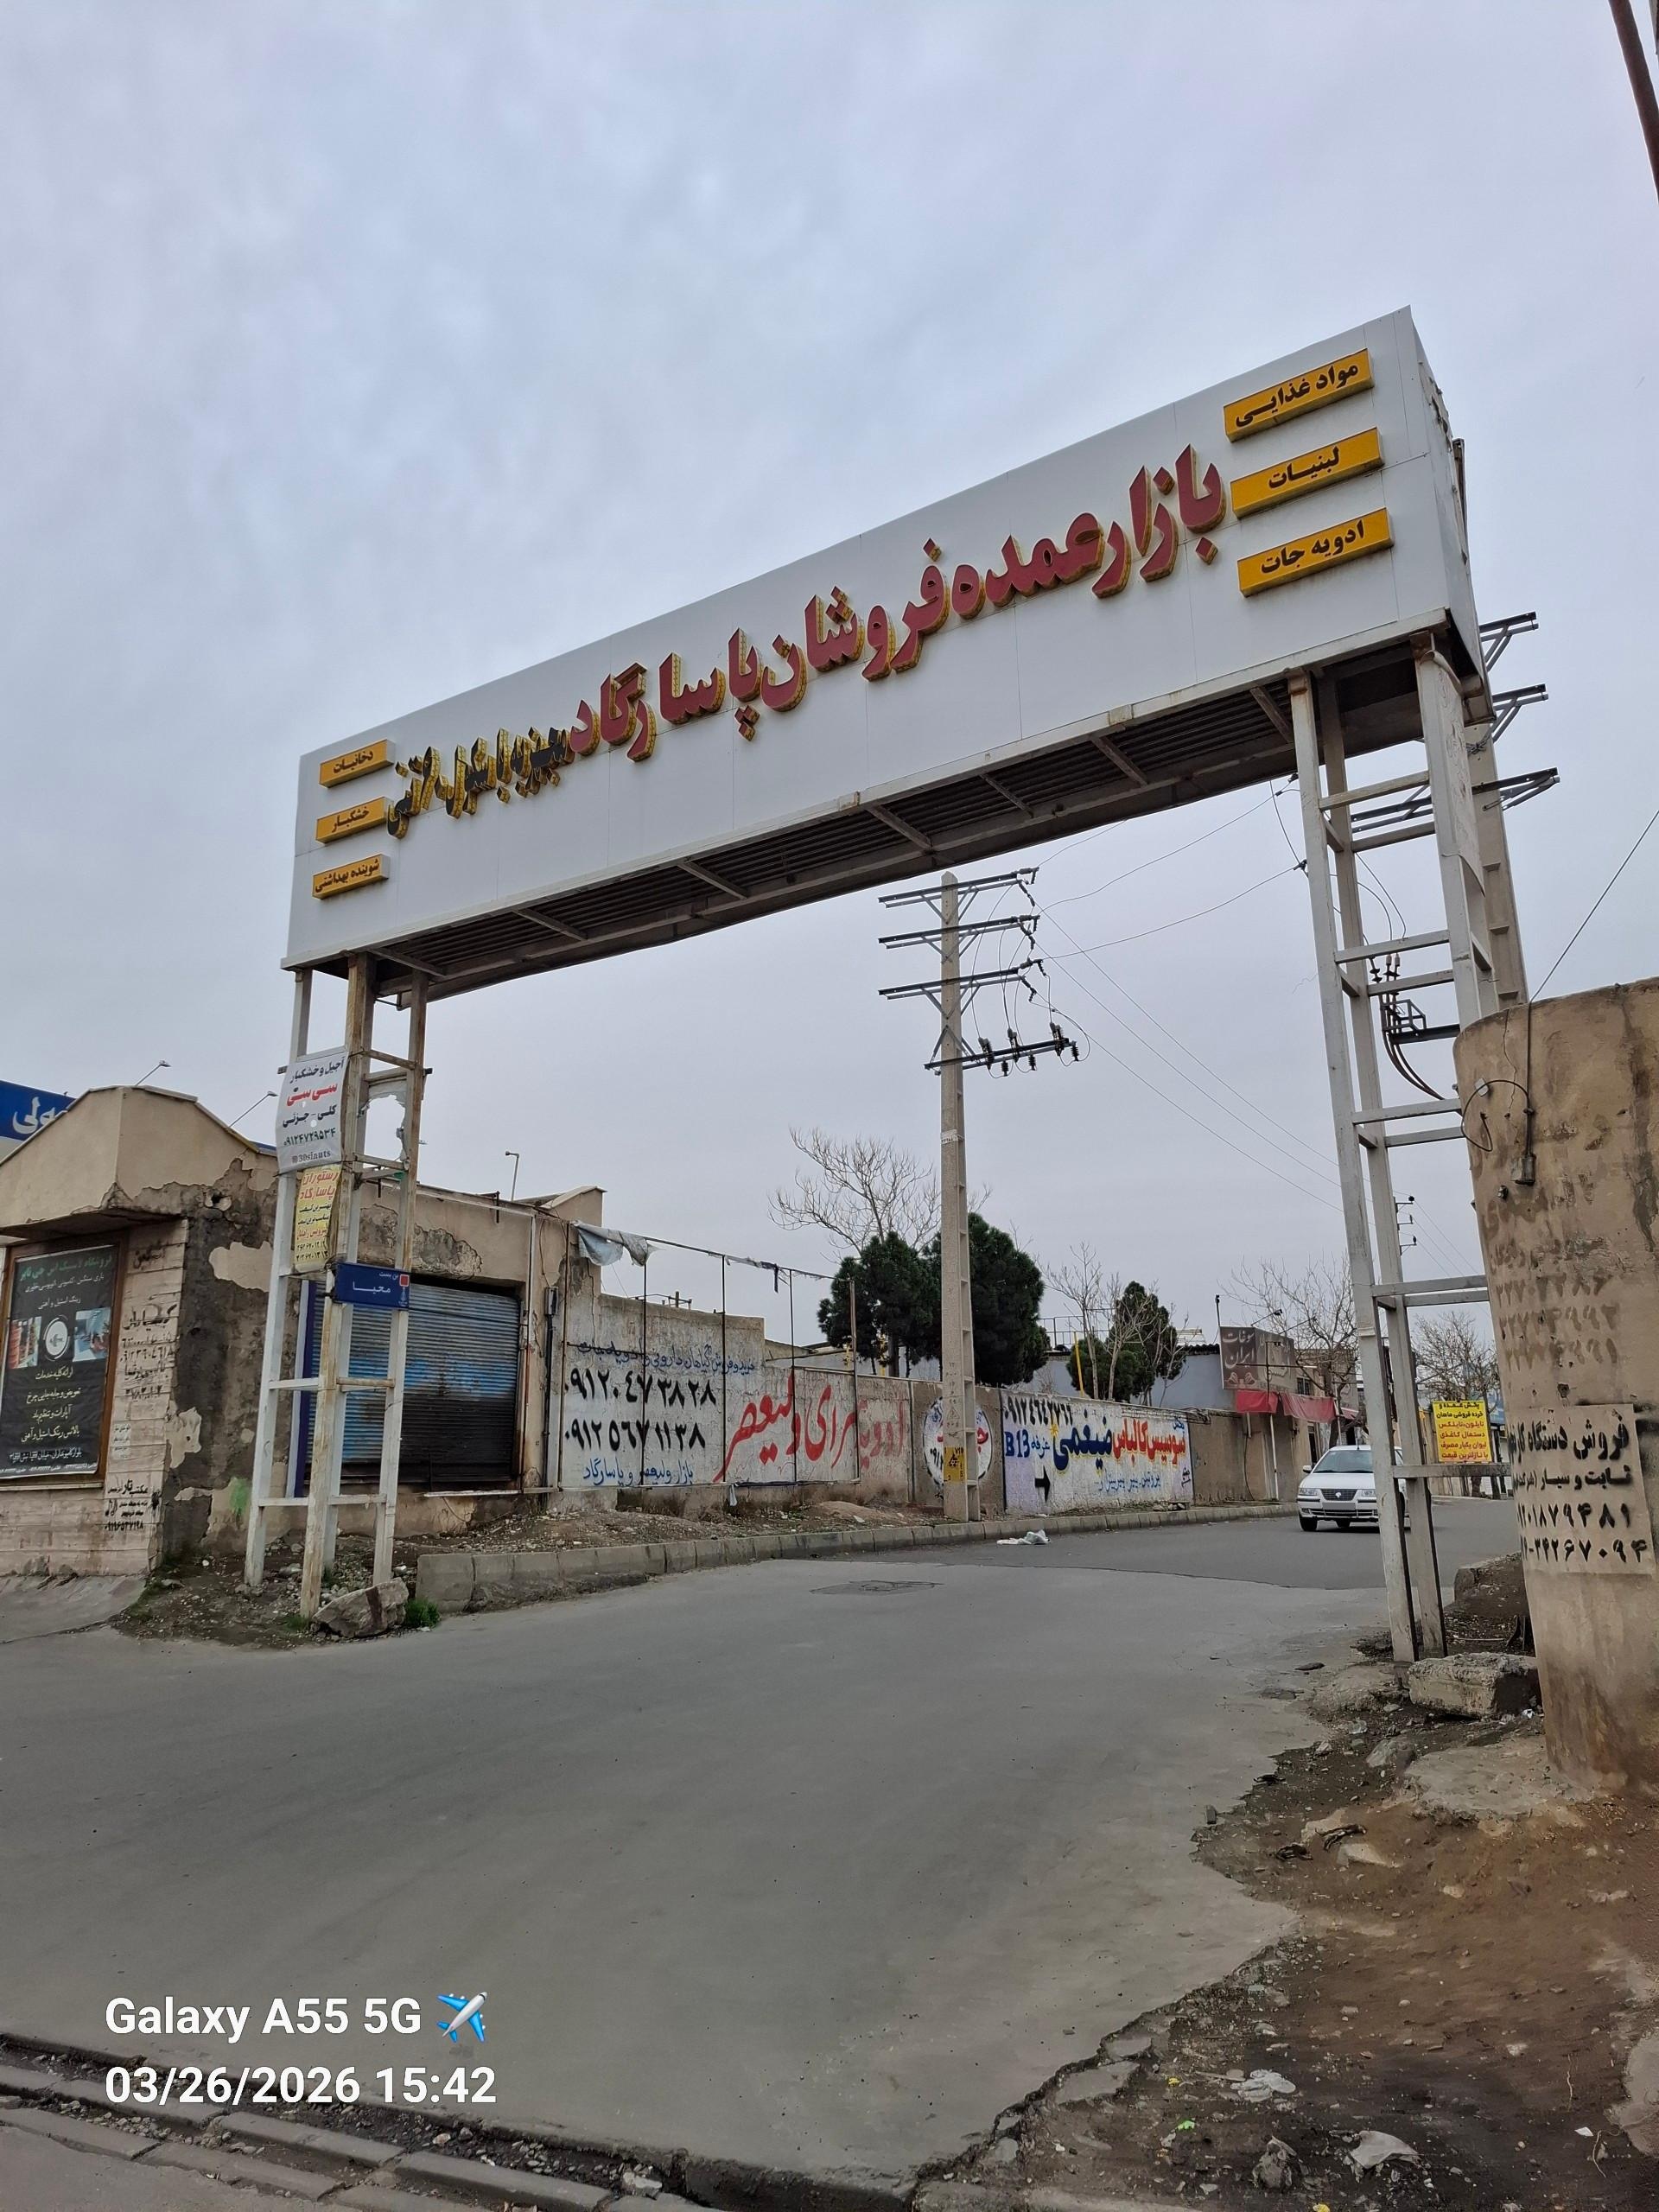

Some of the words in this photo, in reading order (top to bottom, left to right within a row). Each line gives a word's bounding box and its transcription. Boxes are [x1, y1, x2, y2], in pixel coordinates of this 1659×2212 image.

[1315, 363, 1358, 390] مواد
[1235, 378, 1311, 428] غذایی
[1268, 446, 1340, 489] لبنیات
[1092, 442, 1227, 599] بازار
[1312, 519, 1363, 557] ادویه
[950, 512, 1104, 620] عمده
[1260, 546, 1305, 575] جات
[760, 537, 950, 712] فروشان
[569, 626, 763, 763] پاسارگاد
[334, 749, 373, 773] دخانیات
[331, 805, 370, 833] خشکبار
[351, 858, 380, 879] شوینده
[315, 873, 349, 893] بهداشتی
[289, 1065, 319, 1084] خشکبار
[320, 1067, 324, 1077] و
[325, 1057, 345, 1075] آجیل
[283, 1111, 309, 1128] جزئی
[317, 1104, 337, 1120] کلی
[303, 1172, 338, 1185] رستوران
[300, 1185, 335, 1200] پاسارگاد
[353, 1281, 391, 1294] محیا
[684, 1344, 712, 1373] گیاهان
[739, 1362, 755, 1376] خرید
[565, 1418, 706, 1452] ۰۹۱۲۵۶۷۱۱۳۸
[1004, 1429, 1030, 1458] B13
[1113, 1418, 1147, 1464] کالباس
[1440, 1441, 1459, 1450] مصرف
[1528, 1421, 1568, 1452] دستگاه
[1573, 1412, 1630, 1460] فروش
[1147, 1433, 1185, 1465] سوسیس
[583, 1457, 624, 1486] پاسارگاد
[1541, 1467, 1570, 1491] سیار
[1573, 1474, 1582, 1491] و
[1585, 1465, 1632, 1490] ثابت
